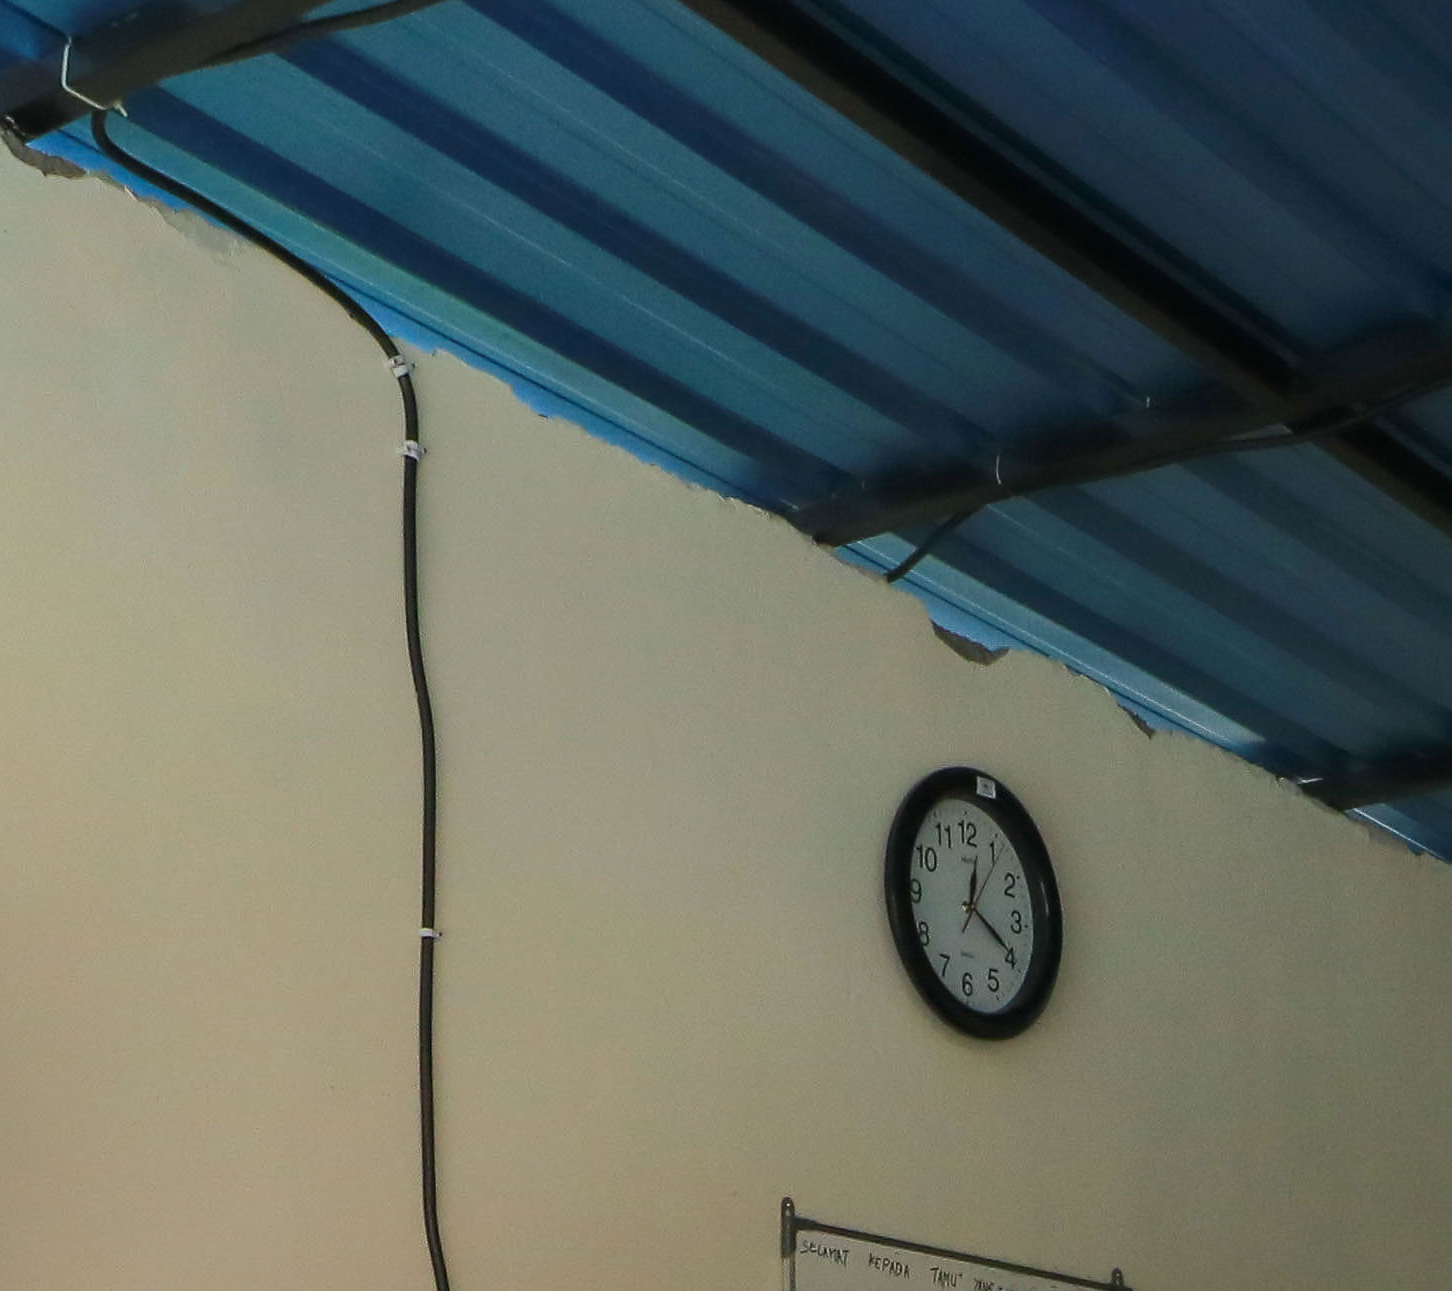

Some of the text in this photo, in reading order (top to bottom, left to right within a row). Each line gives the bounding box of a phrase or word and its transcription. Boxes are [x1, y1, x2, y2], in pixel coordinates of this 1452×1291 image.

[935, 823, 952, 849] 11
[958, 820, 978, 848] 12
[916, 846, 938, 873] 10
[990, 841, 997, 864] 1
[912, 879, 923, 904] 9
[1004, 873, 1016, 898] 2
[919, 921, 930, 947] 8
[1011, 911, 1022, 934] 3
[939, 953, 951, 977] 7
[1005, 947, 1017, 971] 4
[962, 972, 974, 997] 6
[987, 968, 999, 993] 5
